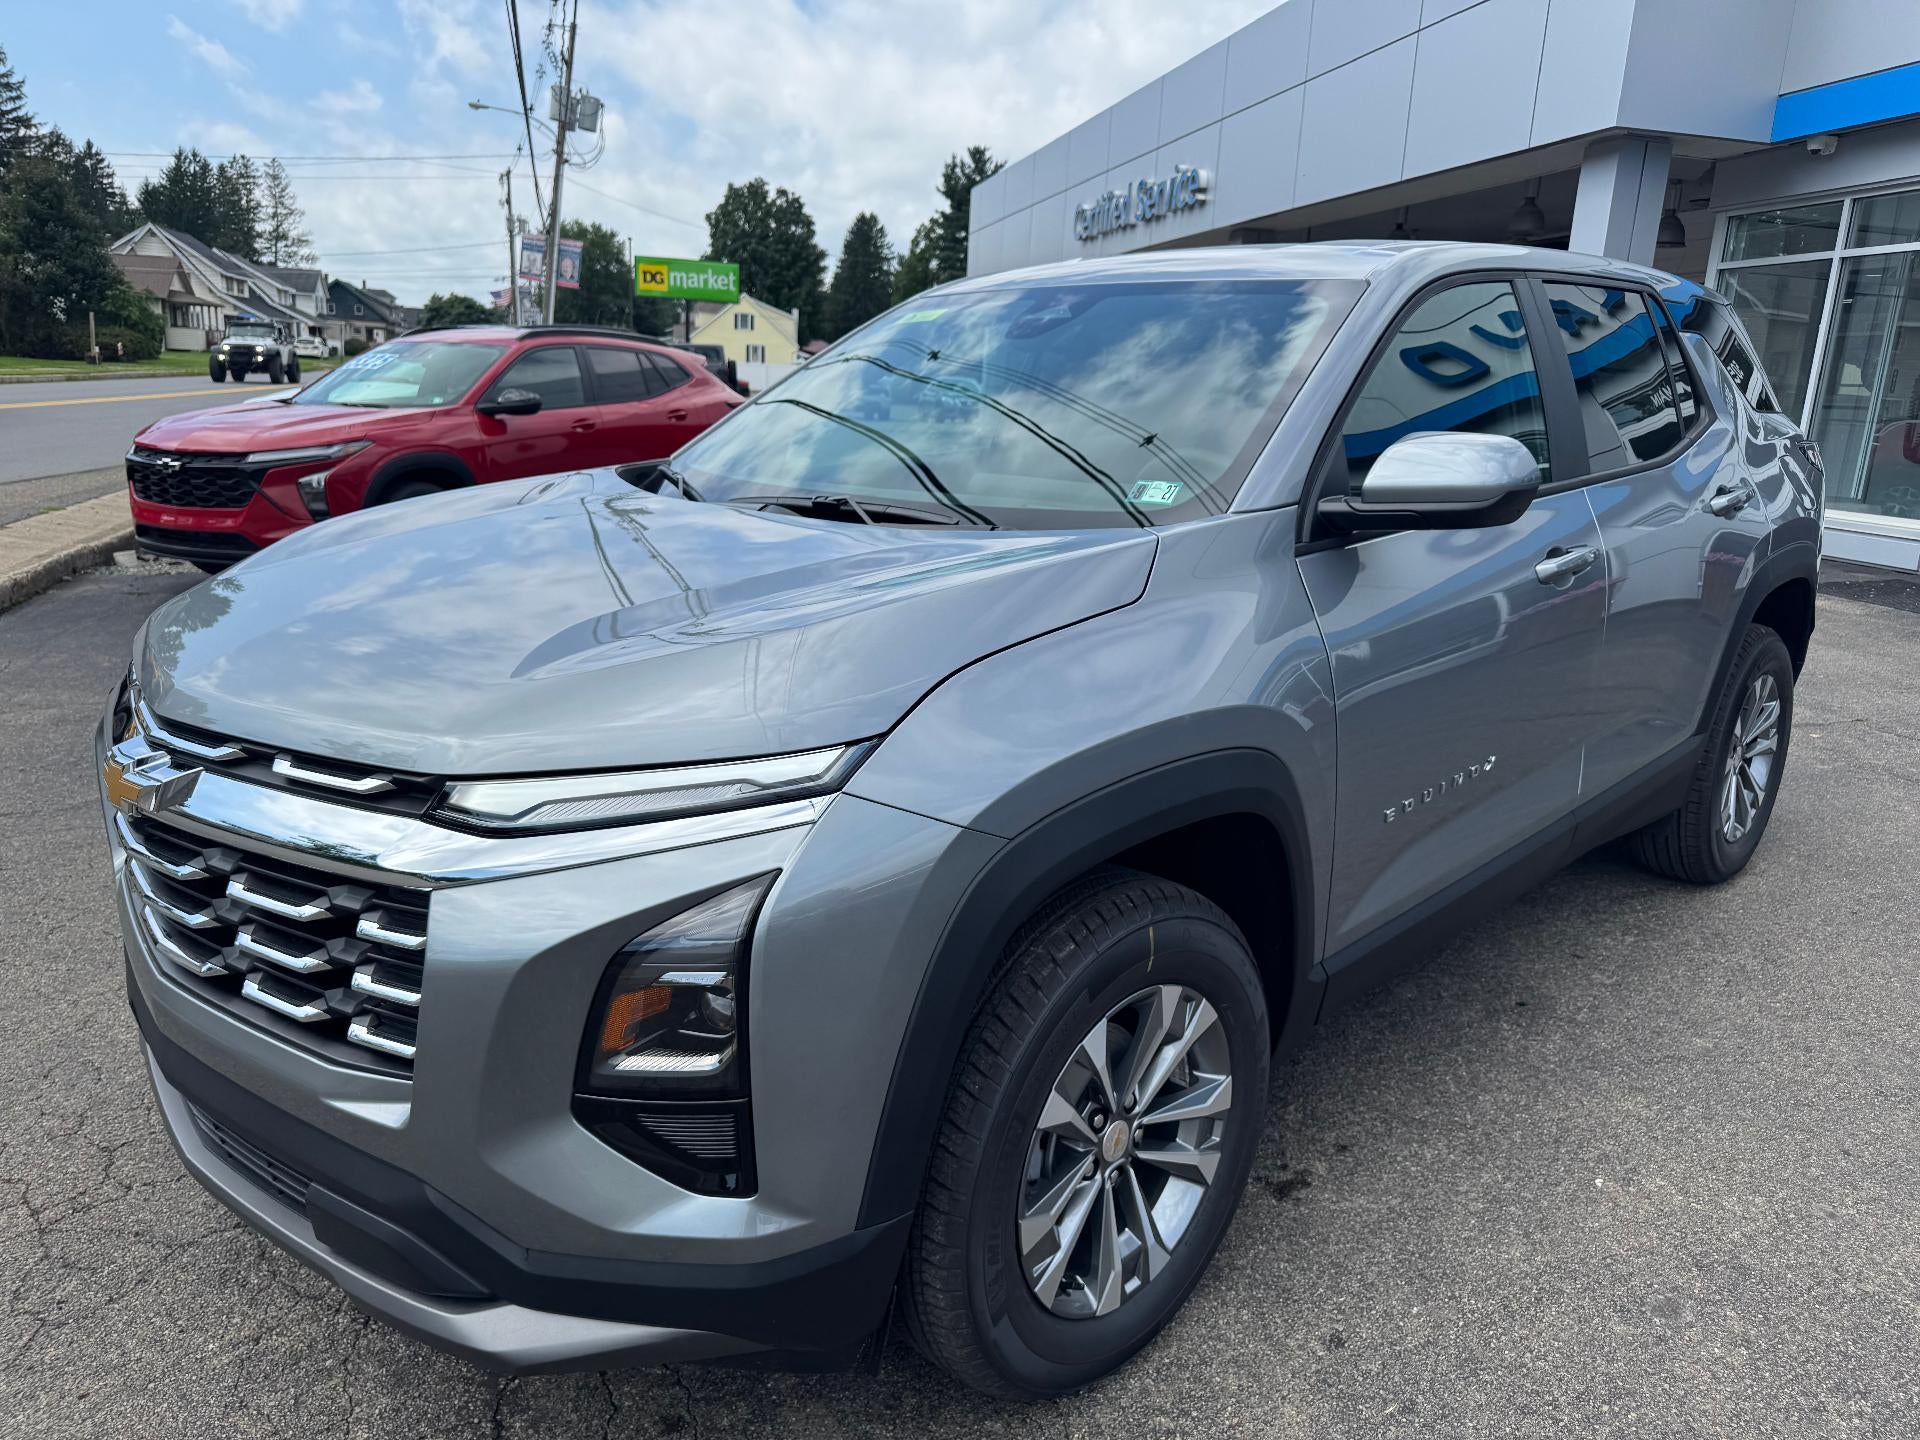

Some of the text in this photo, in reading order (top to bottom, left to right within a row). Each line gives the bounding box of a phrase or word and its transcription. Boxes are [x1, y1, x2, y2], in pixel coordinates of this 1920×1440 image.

[1135, 164, 1209, 224] Service
[642, 269, 737, 292] DG market
[1161, 484, 1178, 501] 27
